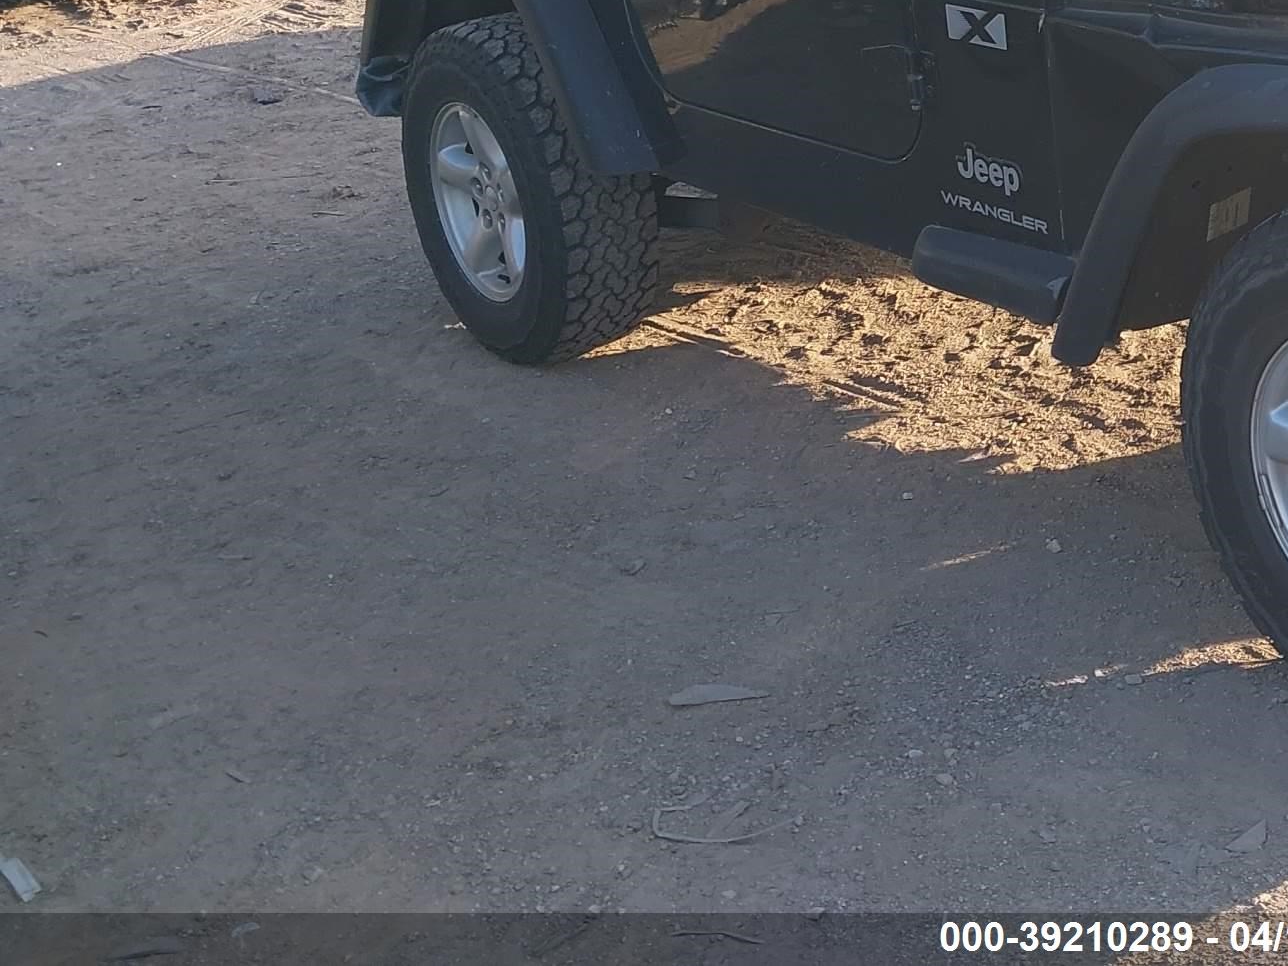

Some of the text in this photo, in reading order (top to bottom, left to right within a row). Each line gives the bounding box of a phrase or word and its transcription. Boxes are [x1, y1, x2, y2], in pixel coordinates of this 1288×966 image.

[952, 6, 1002, 47] X
[956, 147, 1021, 196] Jeep
[940, 189, 1049, 235] WRANGLER
